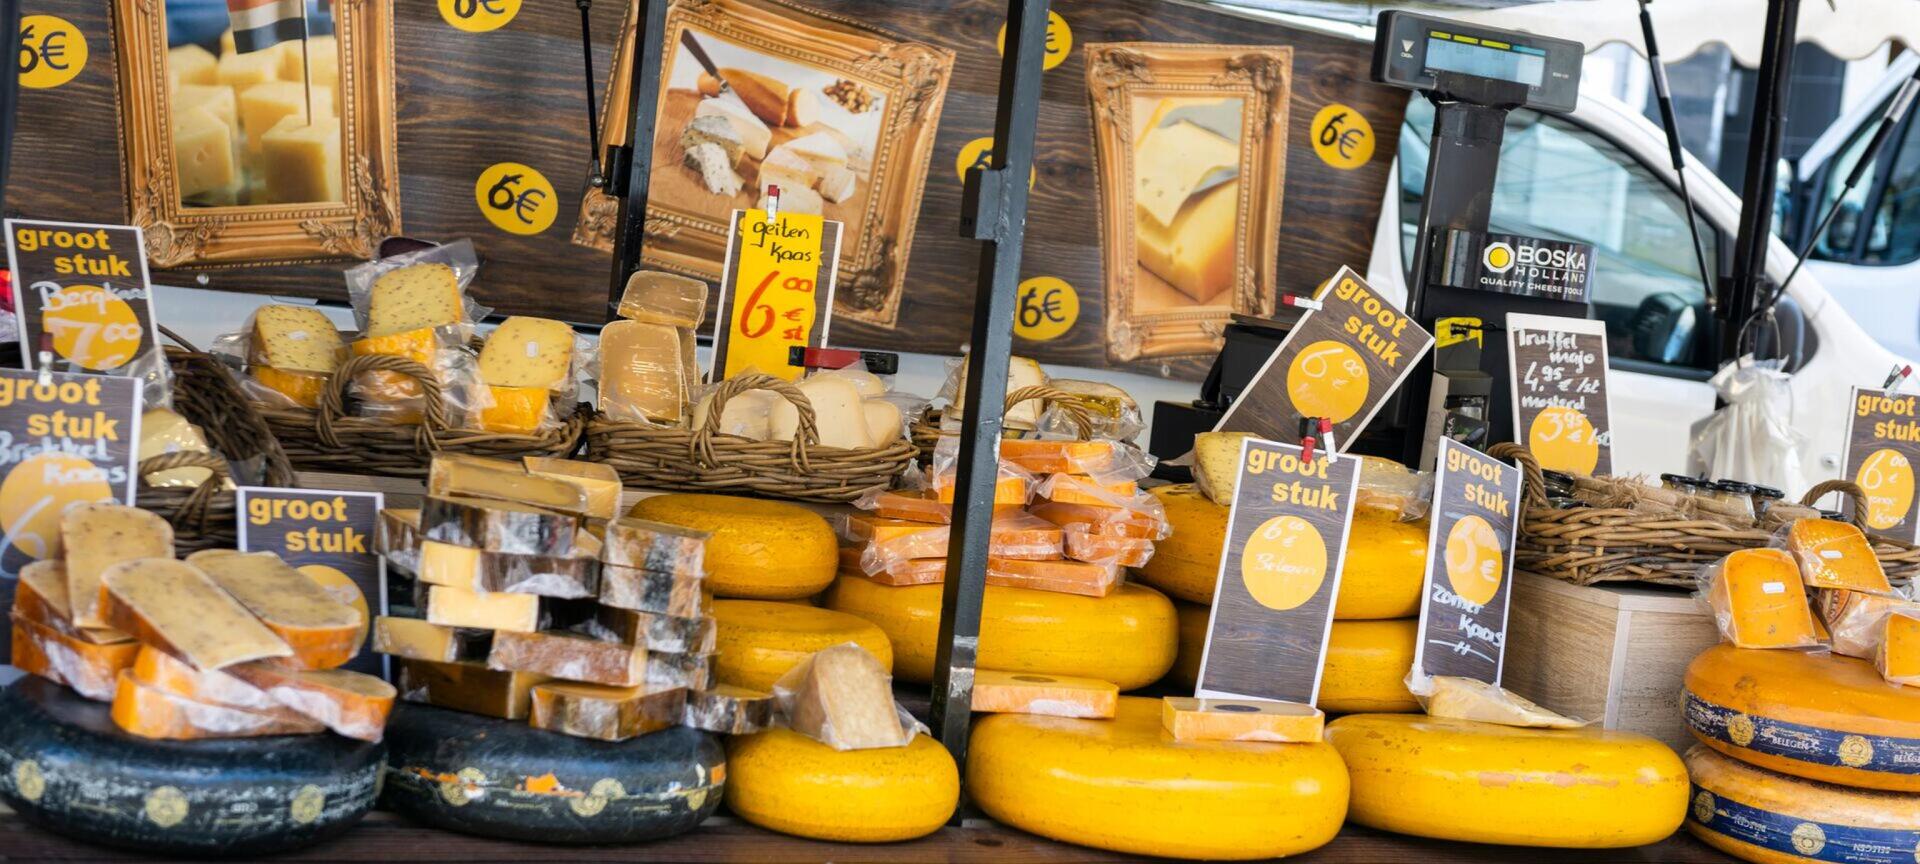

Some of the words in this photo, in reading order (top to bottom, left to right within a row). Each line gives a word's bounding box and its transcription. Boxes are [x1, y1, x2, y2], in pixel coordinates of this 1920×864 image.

[18, 24, 70, 74] 6€
[1319, 111, 1366, 160] 6€
[487, 174, 546, 225] 6€
[16, 228, 111, 252] groot
[54, 253, 132, 277] stuk
[1516, 244, 1586, 271] BOSKA
[1480, 276, 1525, 288] QUALITY
[1527, 282, 1562, 294] CHEESE
[1564, 286, 1583, 297] TOOLS
[1514, 265, 1585, 284] HOLLAND
[1018, 286, 1066, 328] 6€
[1335, 277, 1409, 339] groot
[1343, 315, 1403, 368] stuk
[0, 376, 102, 406] groot
[1857, 393, 1916, 417] groot
[27, 409, 119, 441] stuk
[1873, 419, 1920, 442] stuk
[1246, 448, 1331, 480] groot
[1446, 446, 1503, 486] groot
[248, 495, 348, 526] groot
[1271, 480, 1340, 511] stuk
[1464, 482, 1510, 518] stuk
[284, 526, 367, 554] stuk
